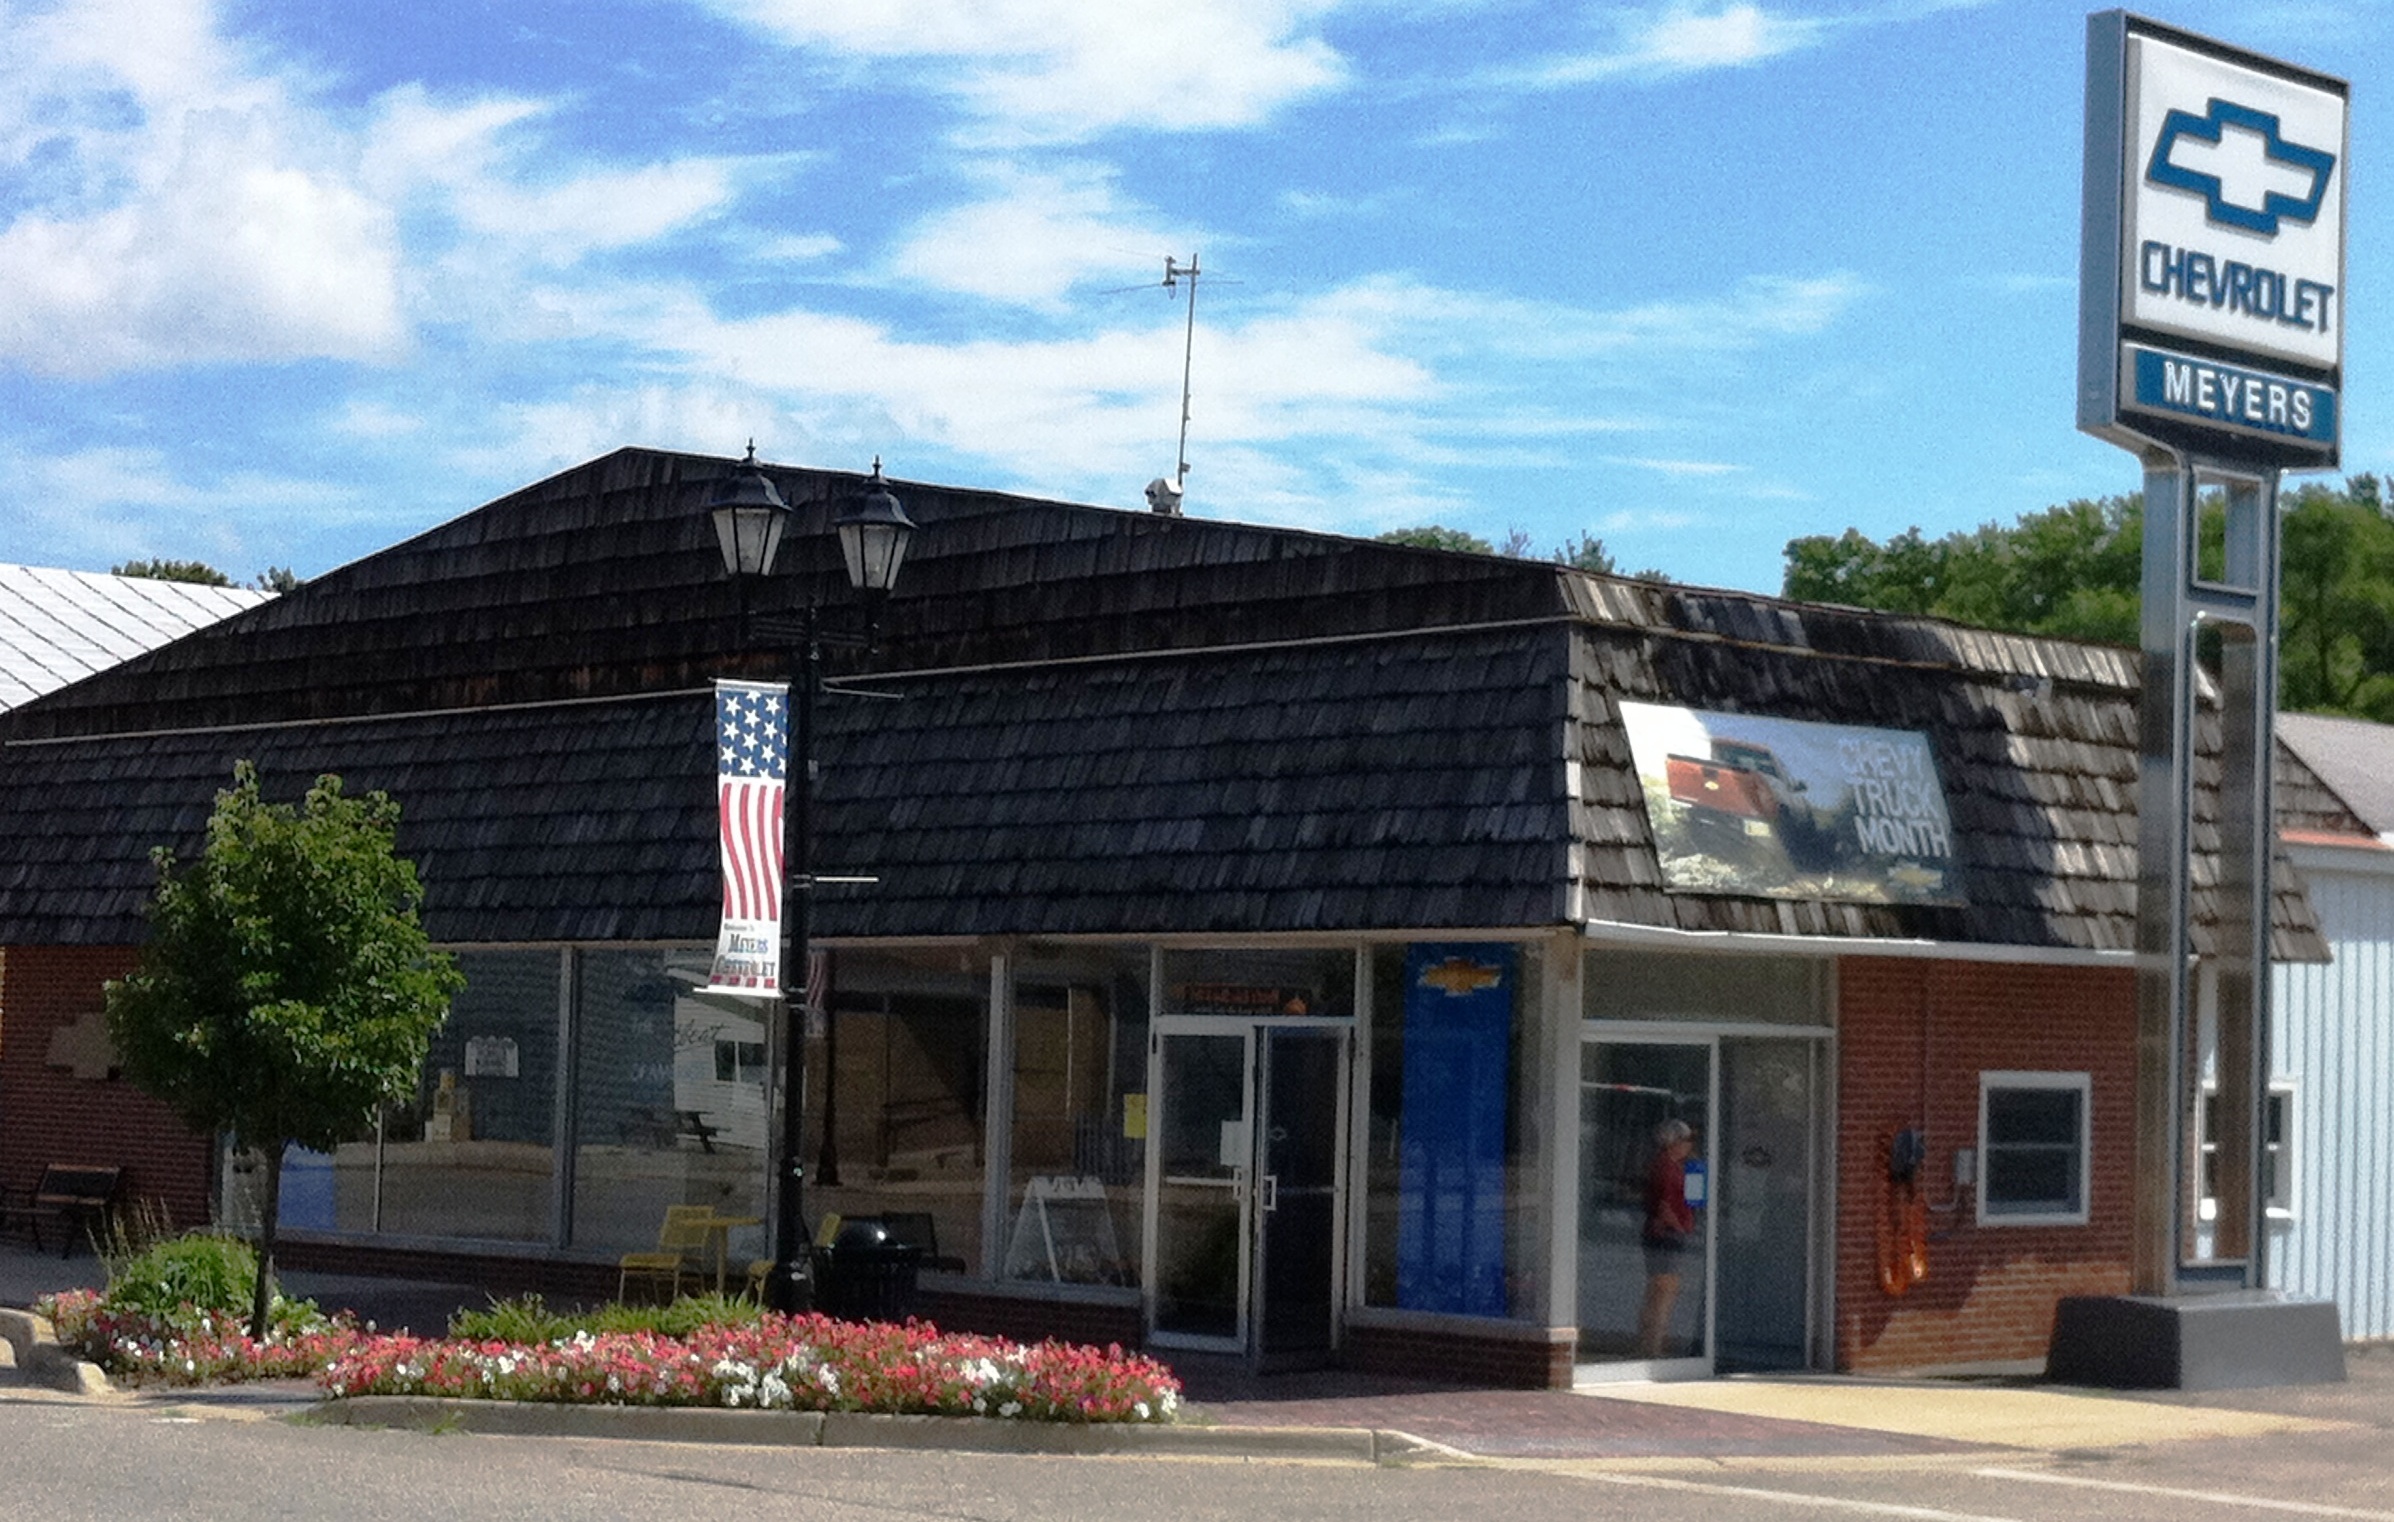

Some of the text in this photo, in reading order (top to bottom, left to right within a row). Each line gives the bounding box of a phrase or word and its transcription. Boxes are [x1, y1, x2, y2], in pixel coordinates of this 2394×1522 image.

[2141, 240, 2335, 333] CHEVROLET
[2164, 361, 2312, 430] MEYERS
[1838, 737, 1924, 780] CHEVY
[1844, 776, 1939, 821] TRUCK
[1854, 815, 1952, 857] MONTH
